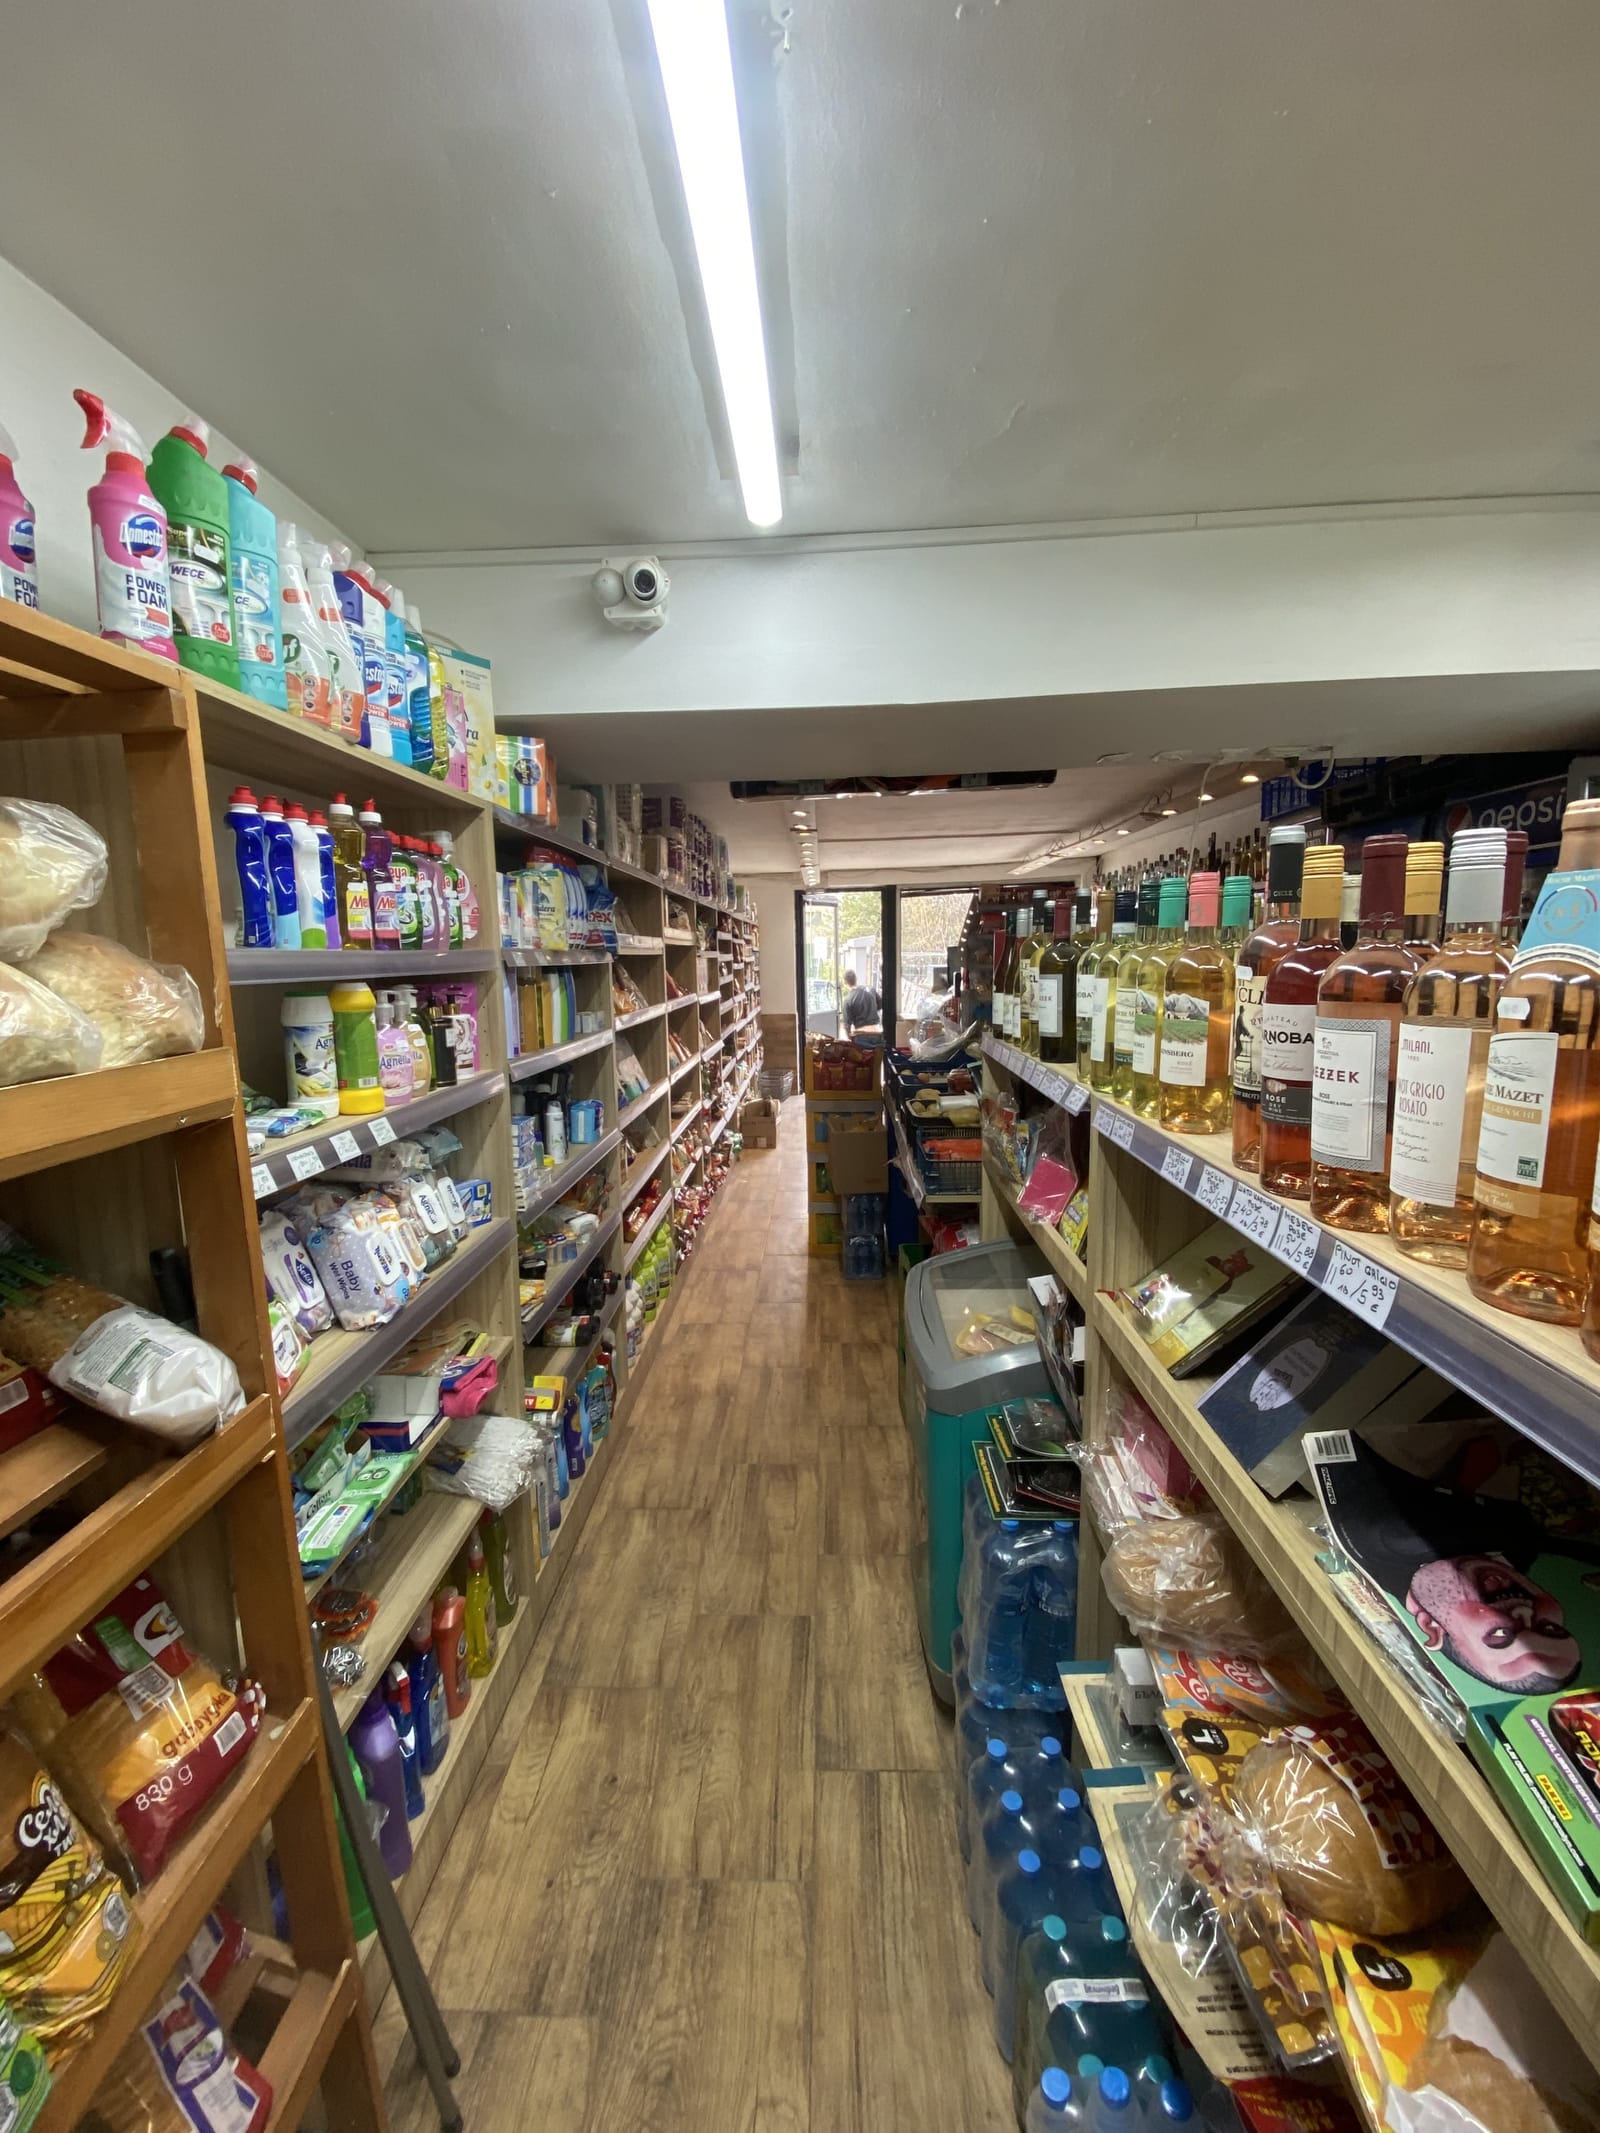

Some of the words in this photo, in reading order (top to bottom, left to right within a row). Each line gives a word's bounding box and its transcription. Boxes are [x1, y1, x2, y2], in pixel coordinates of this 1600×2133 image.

[126, 574, 167, 596] POWER
[127, 586, 168, 611] FOAM
[379, 1054, 411, 1070] Agnella
[1410, 1081, 1445, 1101] GRIGIO
[1495, 1084, 1544, 1105] MAZET
[1335, 1244, 1361, 1268] PINOT
[340, 1260, 361, 1292] Baby
[1371, 1284, 1384, 1301] 93
[1503, 1742, 1518, 1761] PLAY
[1530, 1718, 1547, 1739] WITH
[1543, 1737, 1558, 1753] XXL
[1553, 1751, 1580, 1785] LIMITED
[1574, 1782, 1599, 1815] EDITION
[136, 1775, 173, 1811] 830
[177, 1763, 193, 1786] g
[1539, 1776, 1570, 1820] PANINI
